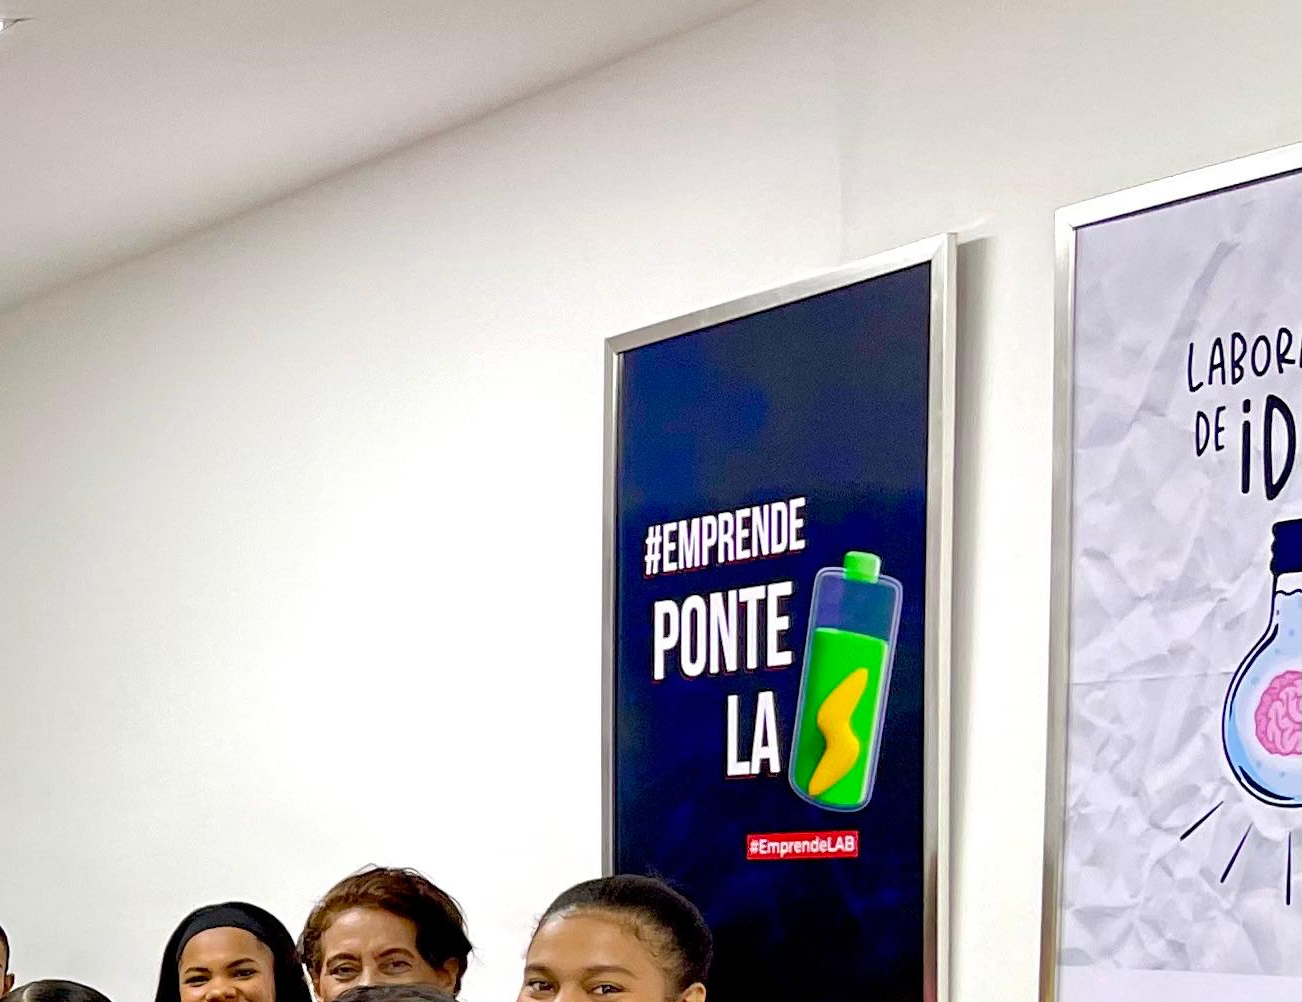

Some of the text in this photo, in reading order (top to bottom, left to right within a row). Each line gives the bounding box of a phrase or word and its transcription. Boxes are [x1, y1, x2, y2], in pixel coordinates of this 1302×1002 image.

[1187, 327, 1302, 392] LABOR
[1195, 406, 1226, 457] DE
[644, 497, 806, 575] #EMPRENDE
[653, 581, 793, 680] PONTE
[727, 691, 780, 776] LA
[749, 835, 855, 858] #EmprendeLAB
